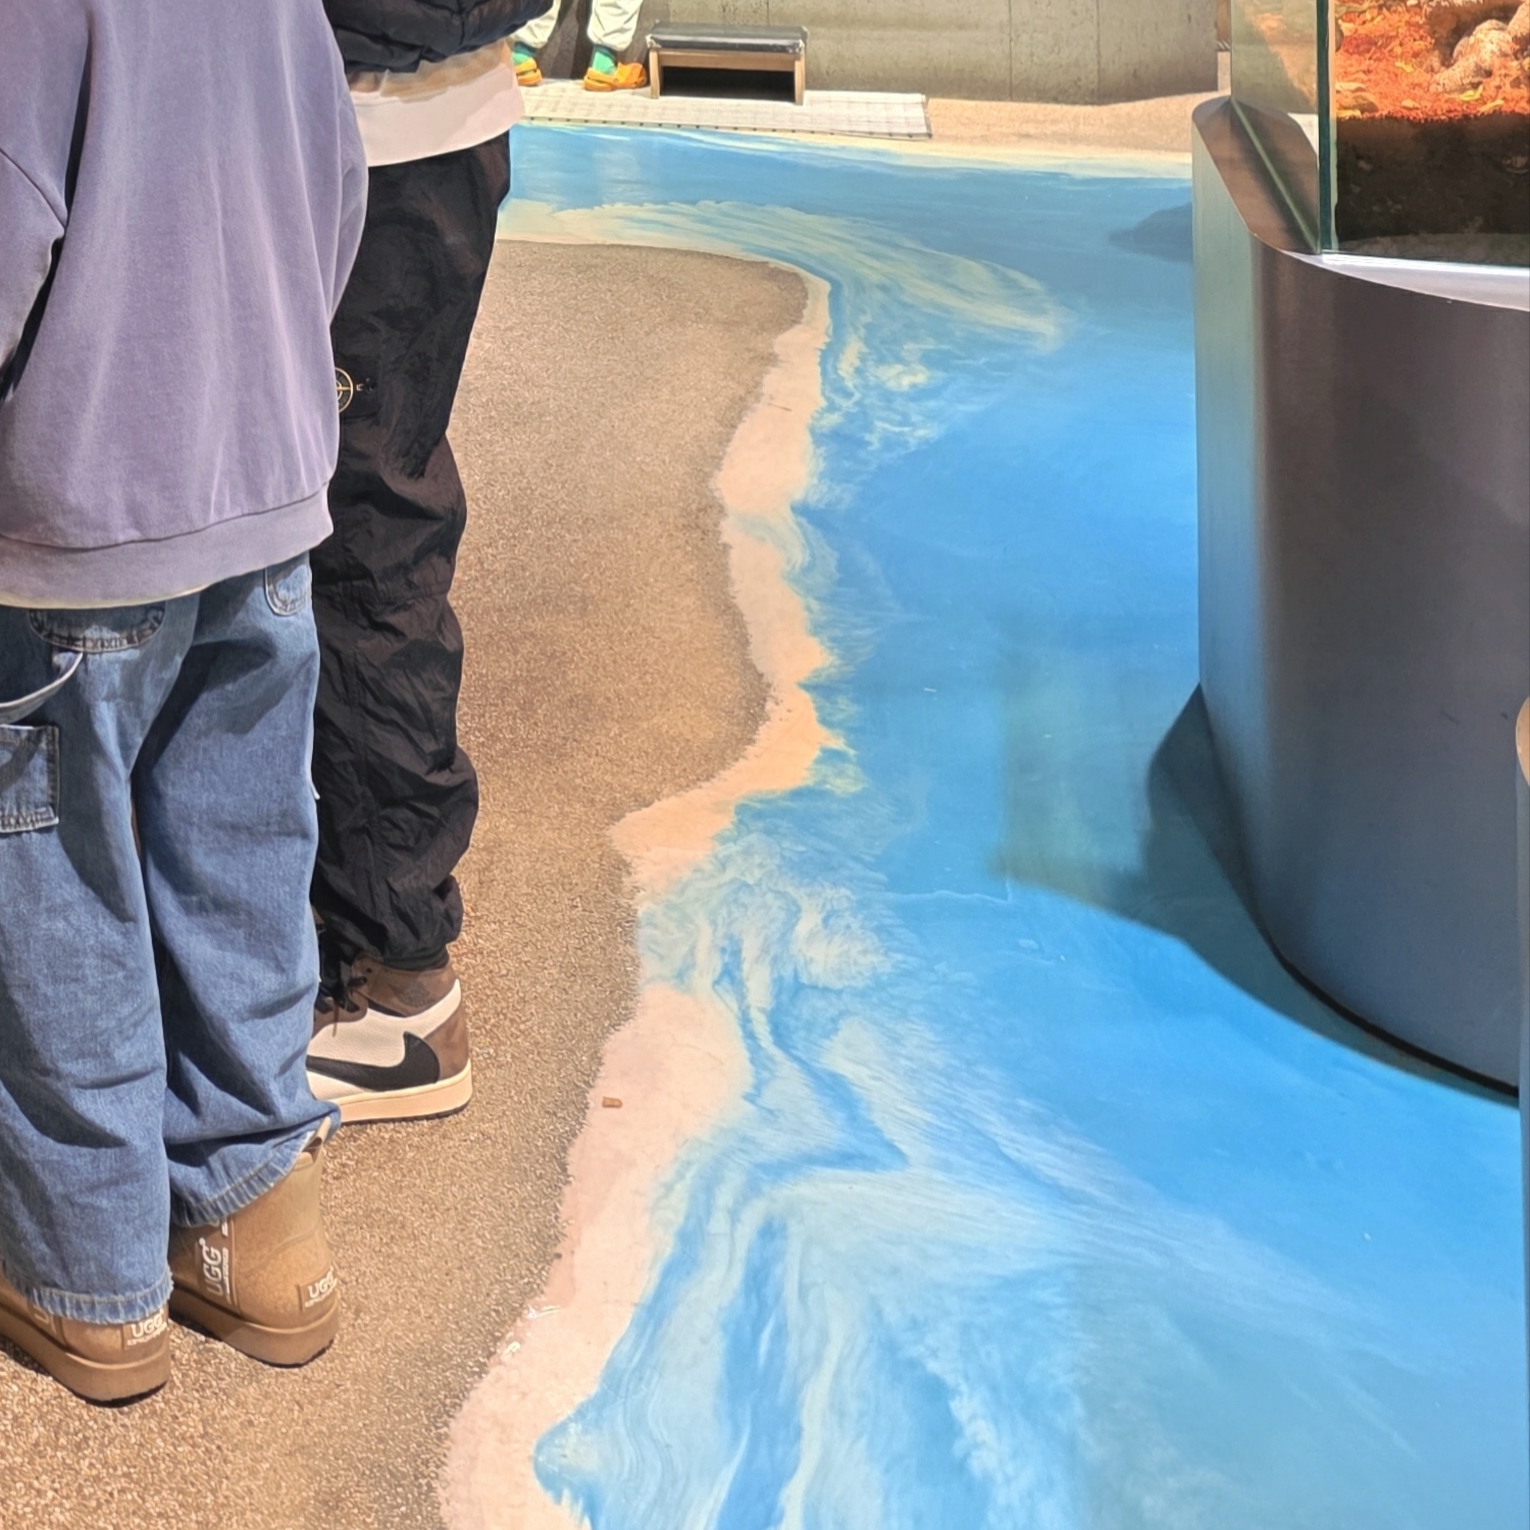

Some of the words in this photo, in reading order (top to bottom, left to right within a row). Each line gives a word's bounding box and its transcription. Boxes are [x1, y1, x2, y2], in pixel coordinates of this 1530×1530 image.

[201, 1245, 224, 1297] UGG
[307, 1270, 334, 1299] UGG
[130, 1312, 163, 1338] UGG
